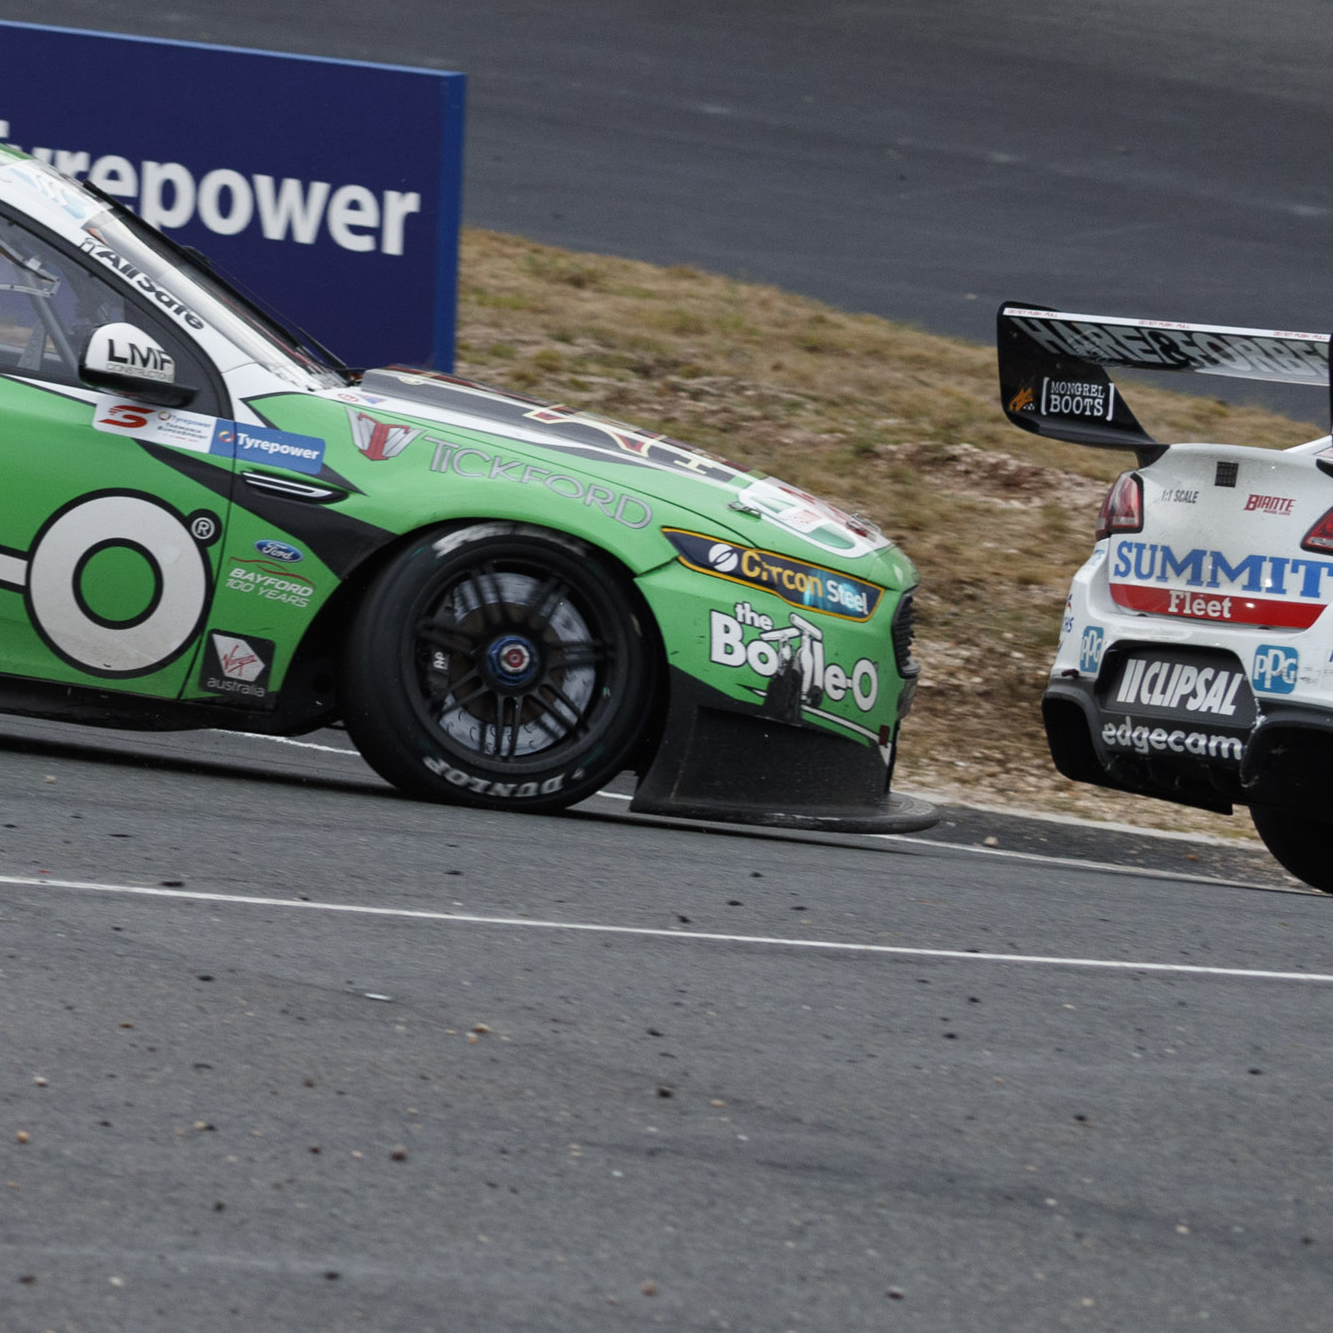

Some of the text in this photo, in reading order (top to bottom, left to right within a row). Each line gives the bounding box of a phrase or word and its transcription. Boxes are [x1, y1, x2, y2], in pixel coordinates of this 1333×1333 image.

[107, 339, 174, 371] LMF
[1051, 380, 1106, 400] MONGREL
[1049, 396, 1105, 418] BOOTS
[237, 432, 320, 460] Tyrepower
[424, 434, 653, 530] TICKFORD
[1173, 489, 1200, 504] SCALE
[1244, 493, 1297, 513] BIANTE
[262, 542, 294, 560] Ford
[229, 567, 314, 597] BAYFORD
[1113, 540, 1333, 598] SUMMIT
[225, 578, 311, 608] 100 YEARS
[826, 579, 870, 615] Steel
[1167, 590, 1233, 619] Fleet
[734, 601, 774, 631] the
[206, 676, 266, 698] australia
[1139, 662, 1244, 716] CLIPSAL
[1101, 716, 1243, 761] edgecam
